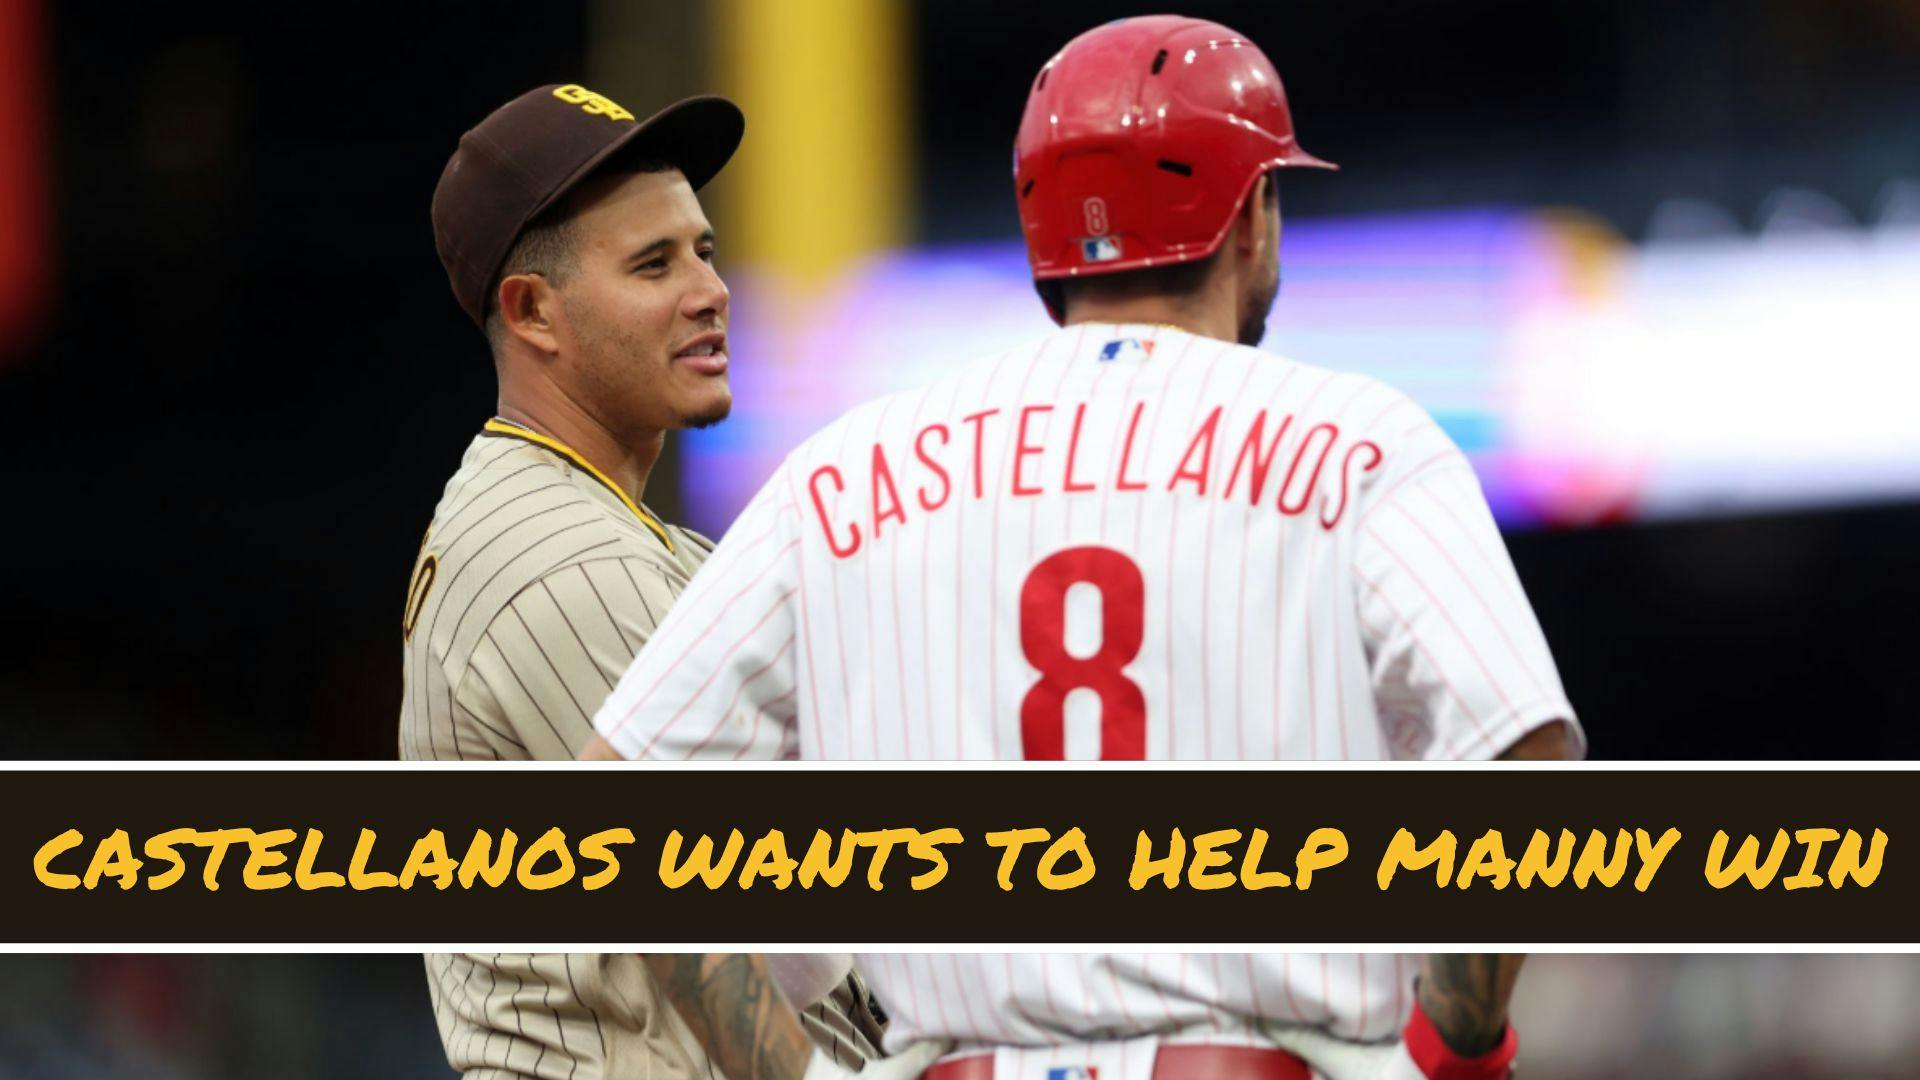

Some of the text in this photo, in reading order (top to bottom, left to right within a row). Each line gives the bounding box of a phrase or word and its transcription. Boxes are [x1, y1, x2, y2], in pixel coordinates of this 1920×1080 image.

[1083, 197, 1109, 237] 8
[808, 403, 1384, 560] CASTELLANOS
[1019, 546, 1147, 760] 8
